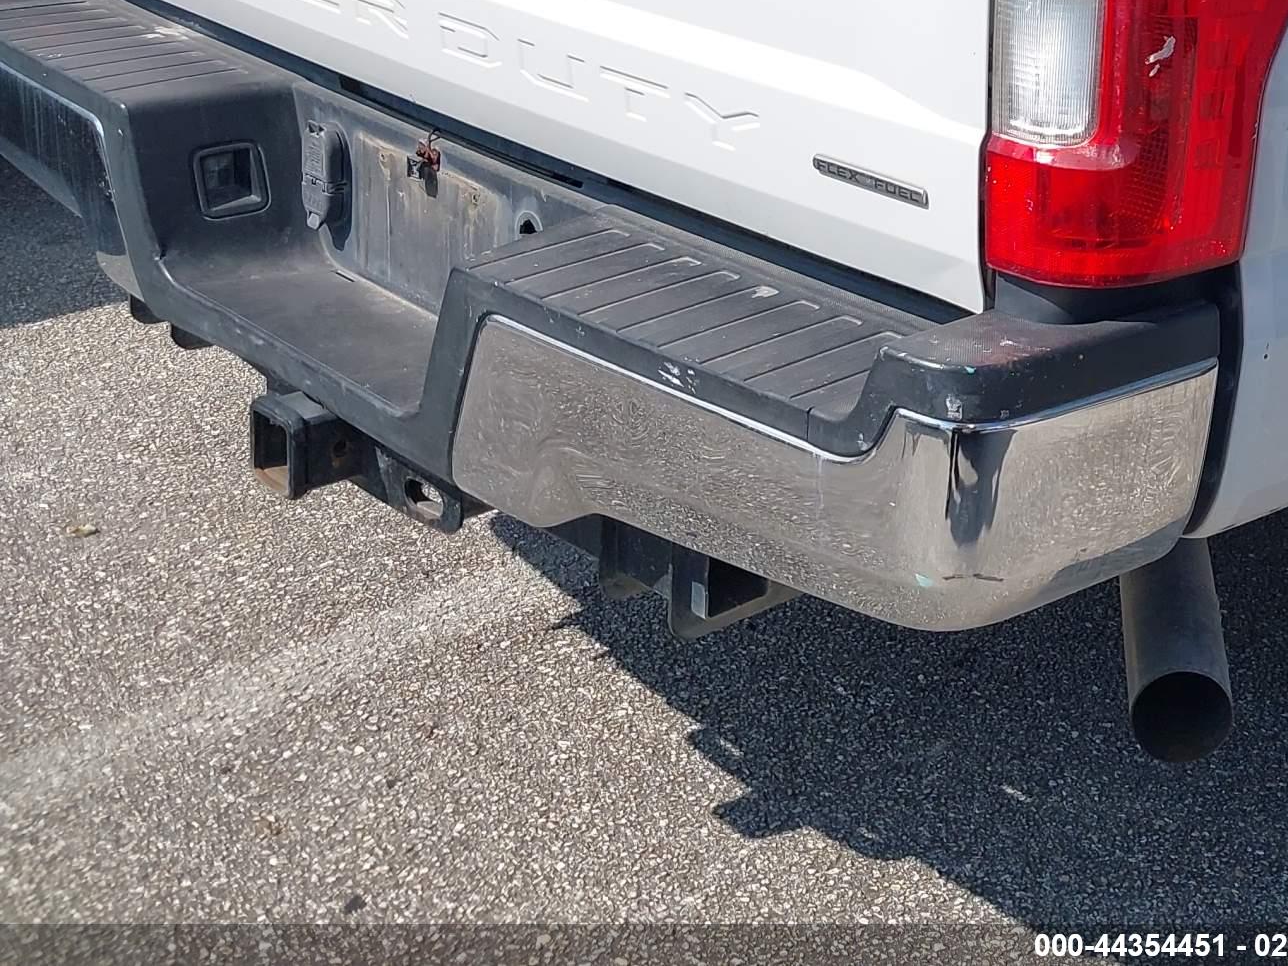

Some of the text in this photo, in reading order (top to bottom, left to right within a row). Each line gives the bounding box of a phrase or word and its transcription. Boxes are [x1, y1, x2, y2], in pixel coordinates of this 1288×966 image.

[438, 11, 761, 151] DUTY
[815, 158, 923, 203] FLEX FUEL
